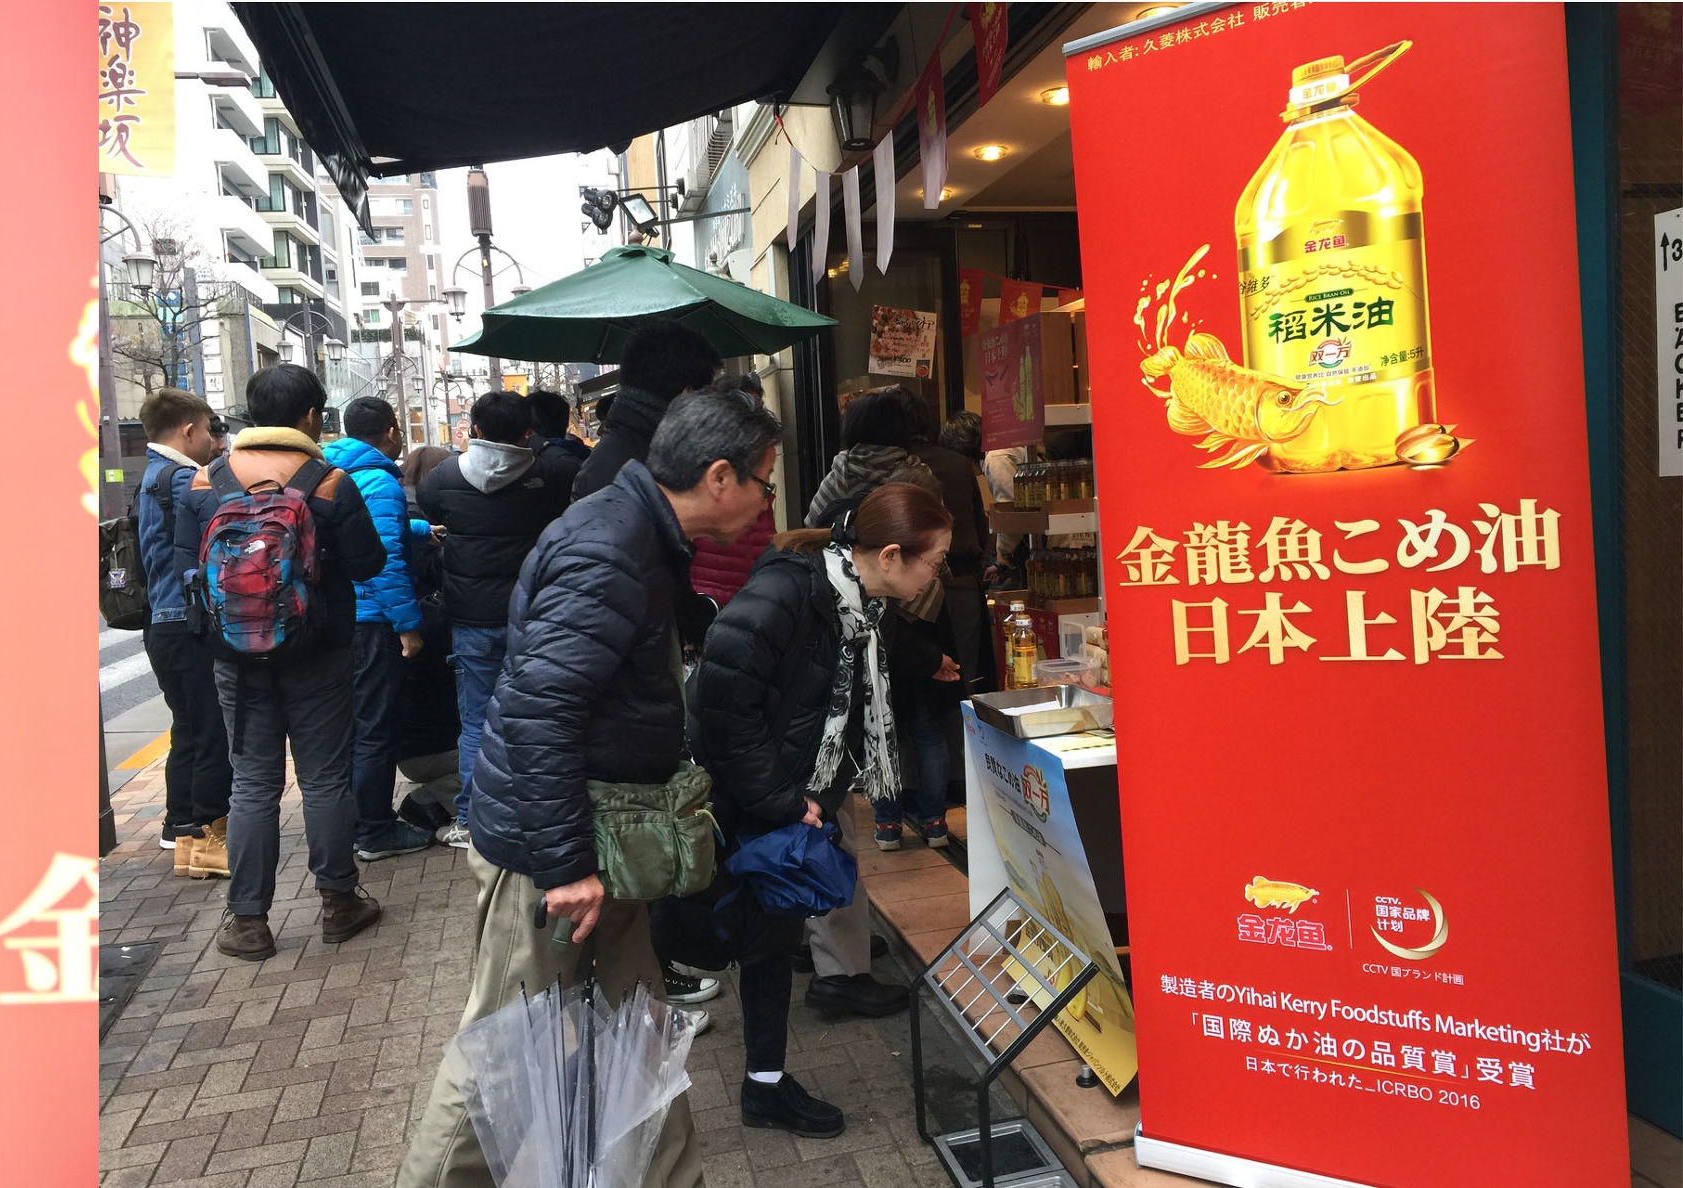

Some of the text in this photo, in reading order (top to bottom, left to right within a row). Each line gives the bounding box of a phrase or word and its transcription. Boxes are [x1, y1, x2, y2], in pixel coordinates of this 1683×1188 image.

[99, 6, 147, 168] 神楽坂
[1304, 234, 1347, 254] 金龙鱼
[1268, 295, 1395, 345] 稻米油
[1116, 498, 1562, 587] 金龍魚こめ油
[1170, 585, 1505, 666] 日本上陸
[1237, 913, 1327, 951] 金龙鱼
[1375, 904, 1431, 922] 国家品牌
[1377, 919, 1404, 933] 计划
[1362, 963, 1465, 986] CCTV 国ブランド計画
[1160, 974, 1592, 1055] 製造者のYihai Kerry Foodstuffs Marketing社が
[1438, 1089, 1481, 1110] 2016
